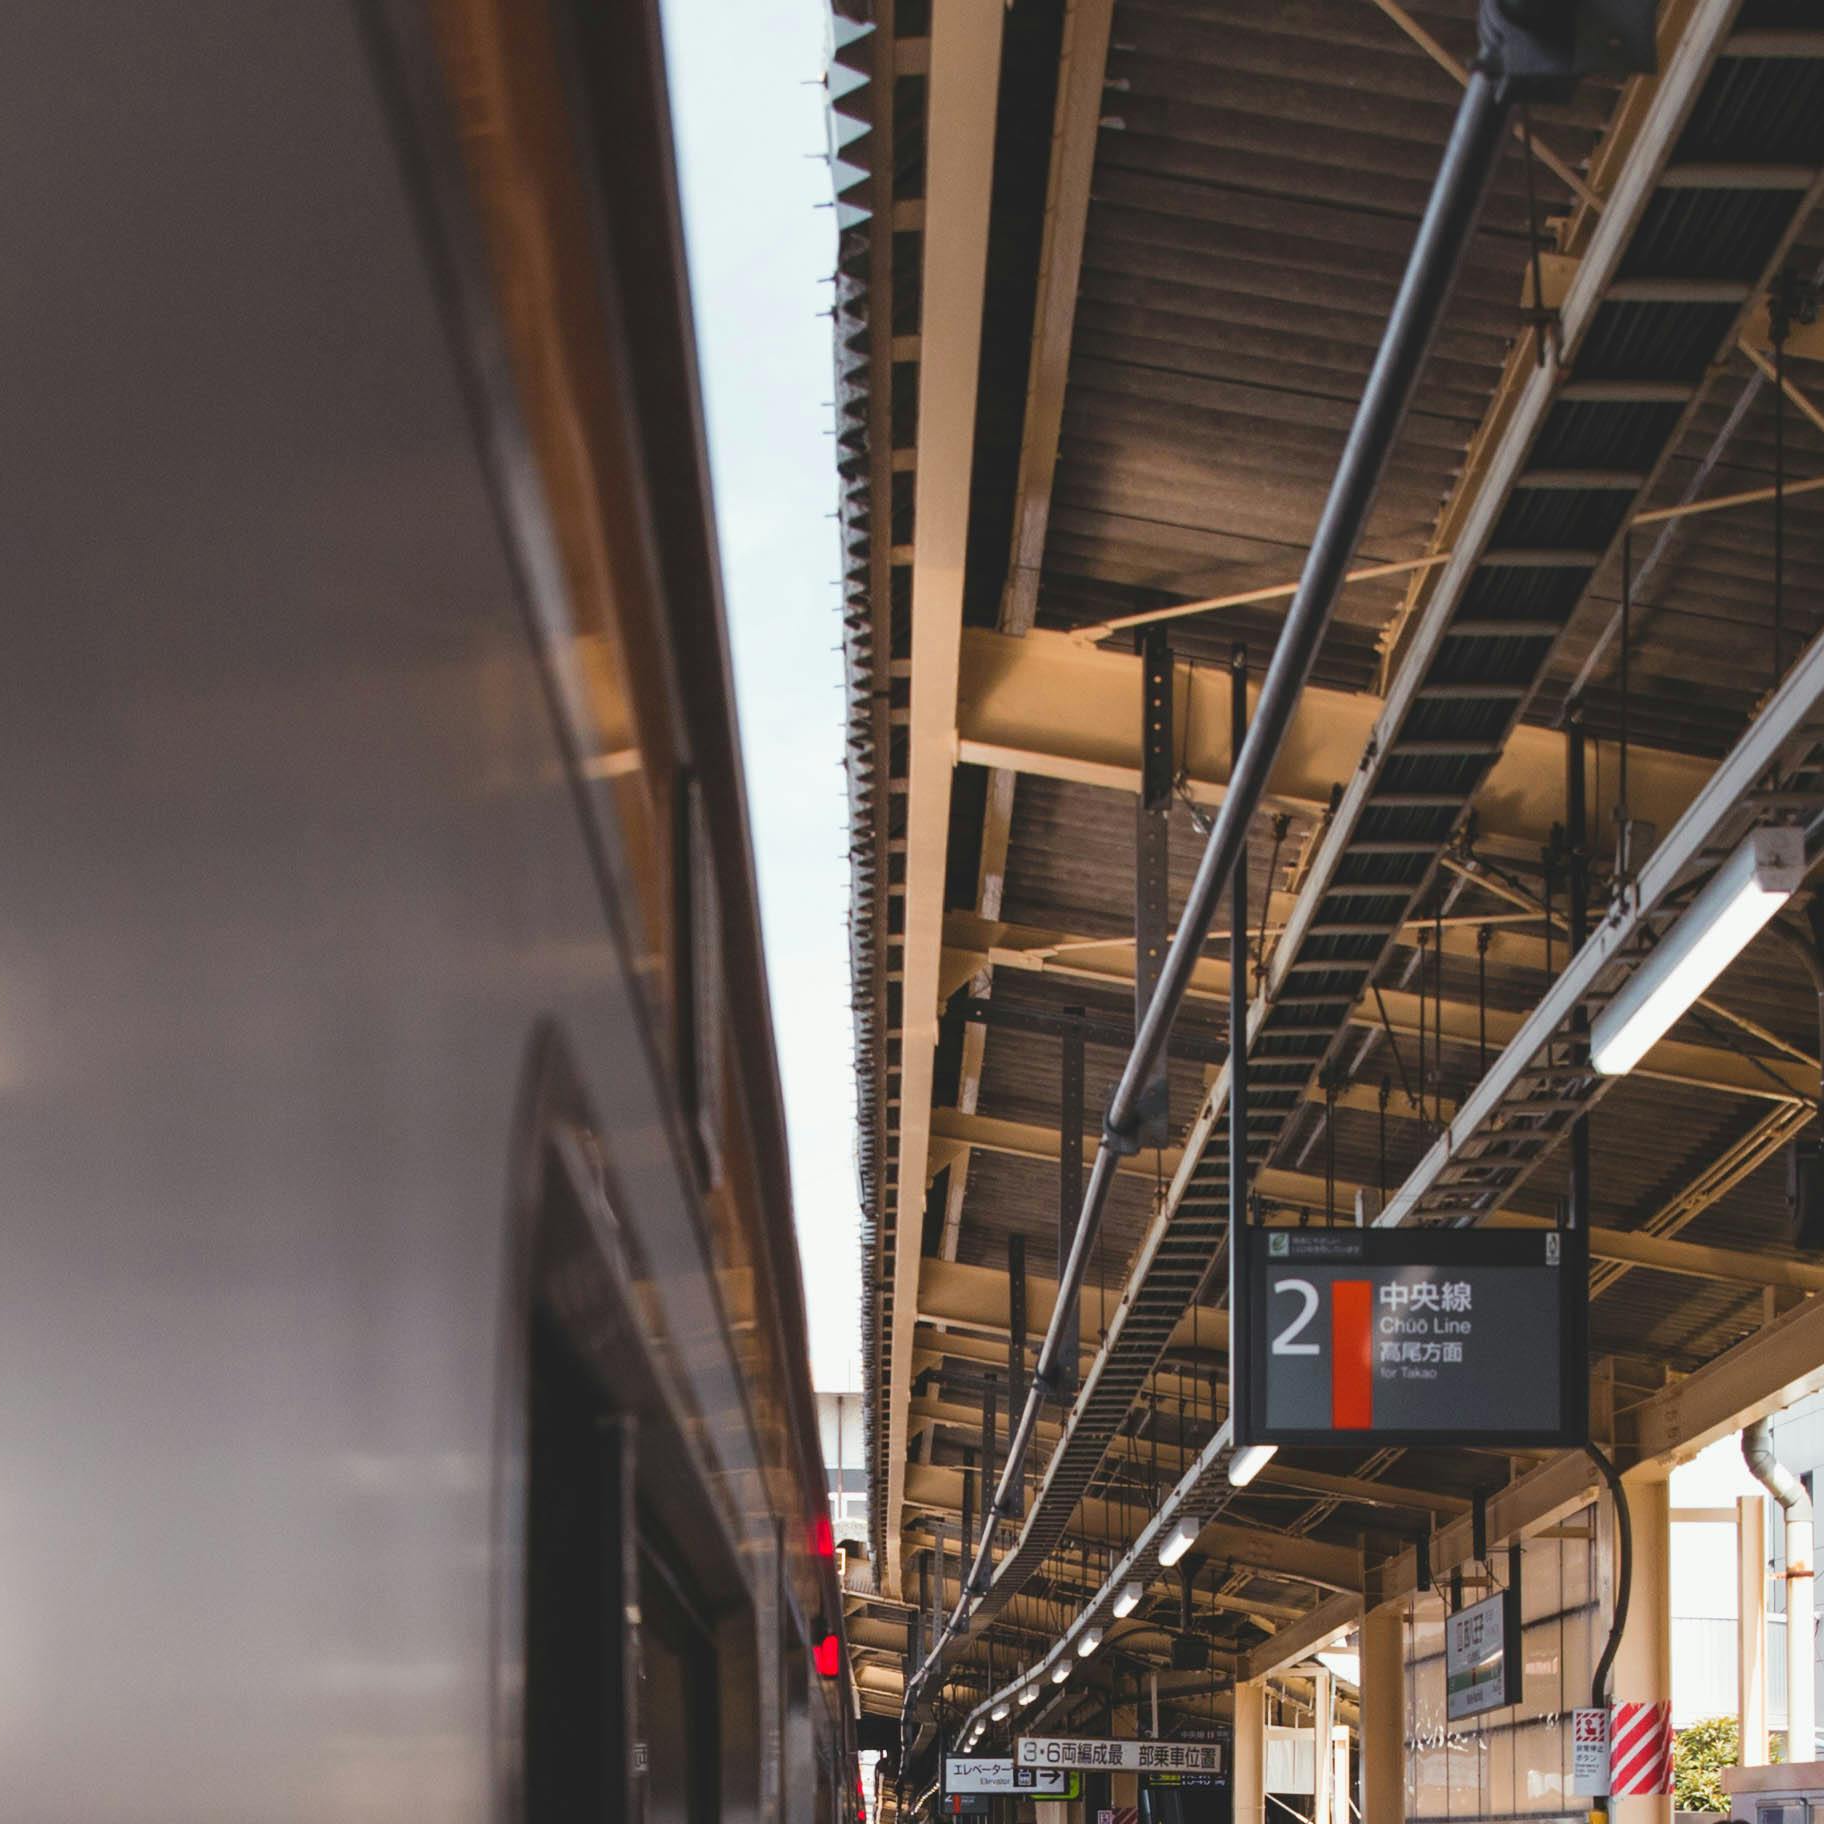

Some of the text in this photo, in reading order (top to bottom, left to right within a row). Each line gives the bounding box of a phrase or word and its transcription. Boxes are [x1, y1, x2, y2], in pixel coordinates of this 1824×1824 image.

[1380, 1281, 1472, 1312] 中央線
[1272, 1279, 1320, 1355] 2
[1434, 1317, 1471, 1334] Line
[1380, 1341, 1463, 1363] 高尾方面
[1380, 1366, 1437, 1378] for Takao
[953, 1764, 1013, 1775] エレベーター
